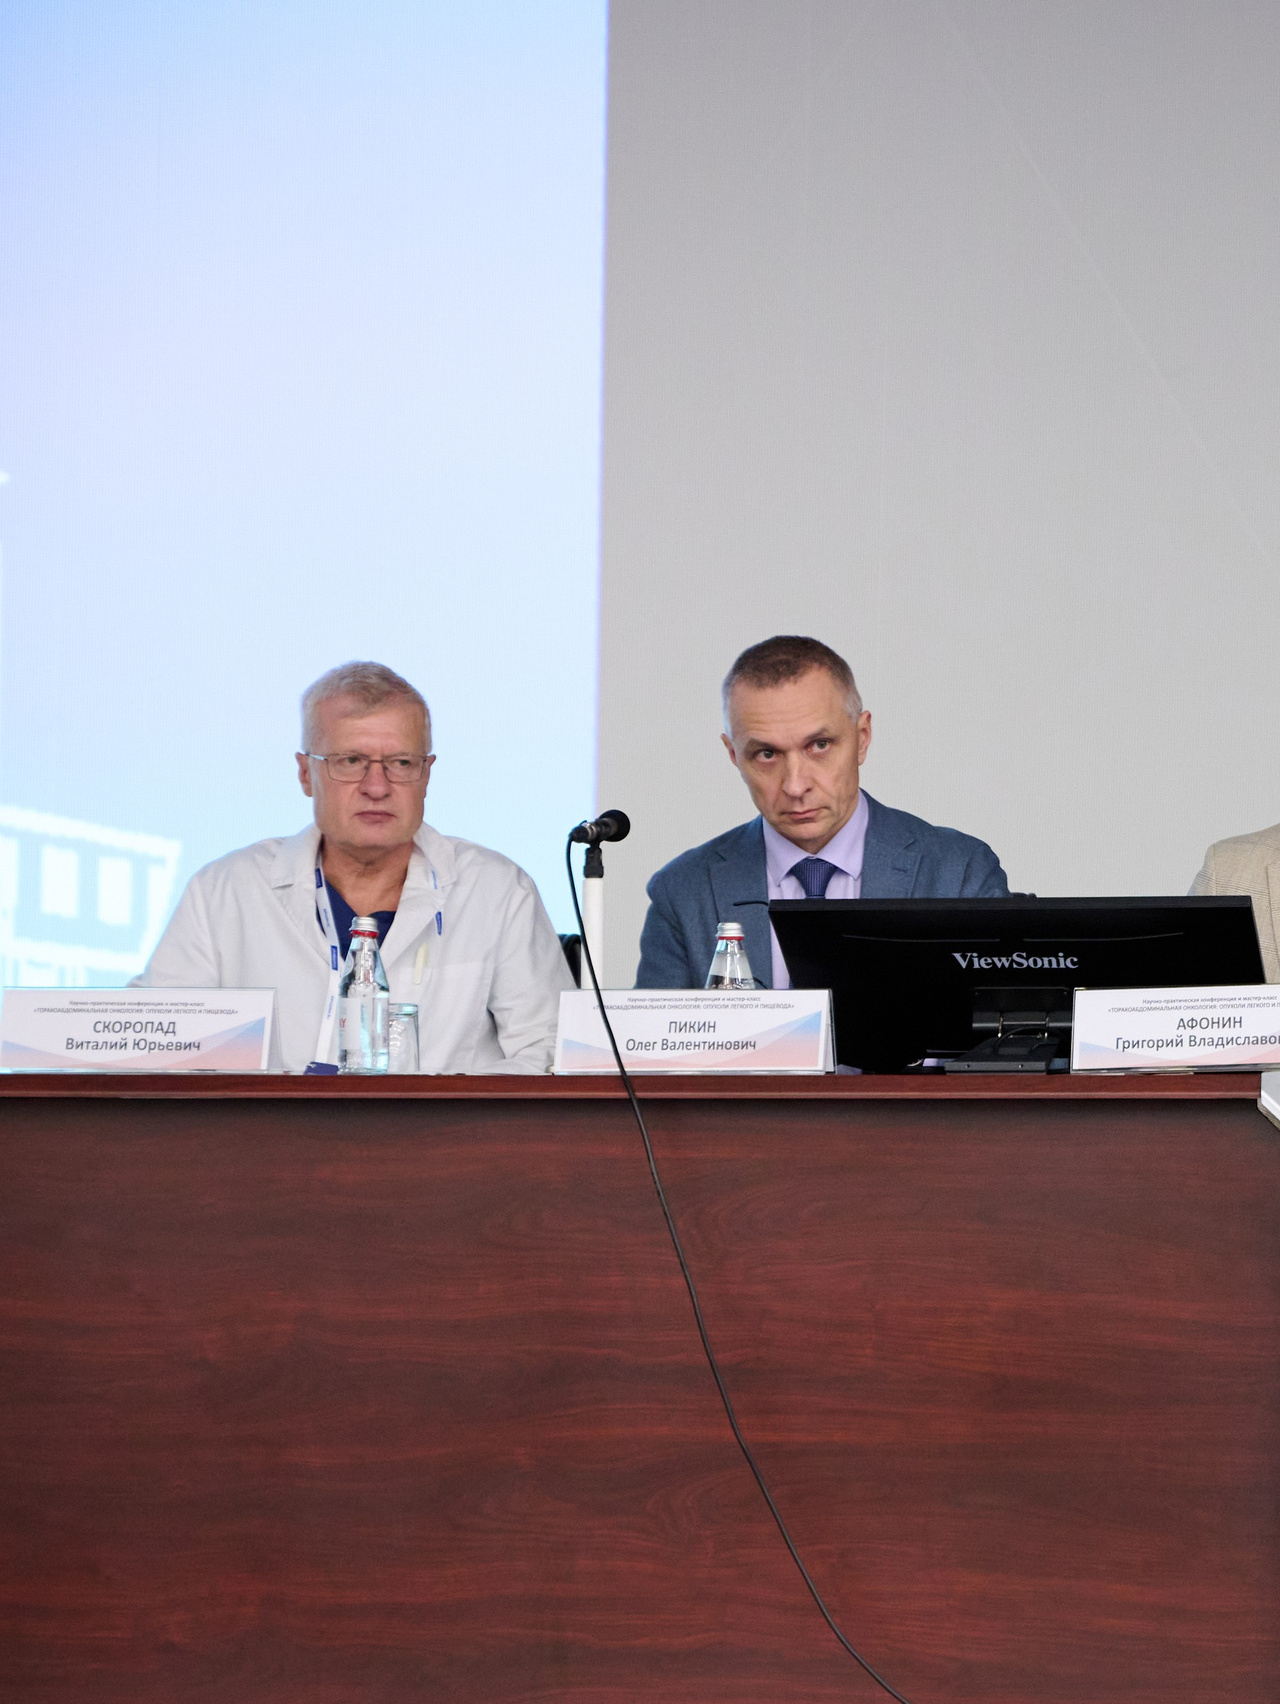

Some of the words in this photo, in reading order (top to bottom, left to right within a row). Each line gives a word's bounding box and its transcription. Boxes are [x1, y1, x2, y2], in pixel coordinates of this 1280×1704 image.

[951, 952, 1079, 969] ViewSonic
[93, 1021, 176, 1036] СКОРОПАД
[669, 1021, 716, 1033] ПИКИН
[1177, 1016, 1243, 1030] АФОНИН
[66, 1037, 127, 1050] Виталий
[133, 1038, 200, 1053] Юрьевич
[626, 1039, 657, 1051] Олег
[661, 1039, 756, 1051] Валентинович
[1116, 1035, 1183, 1052] Григорий
